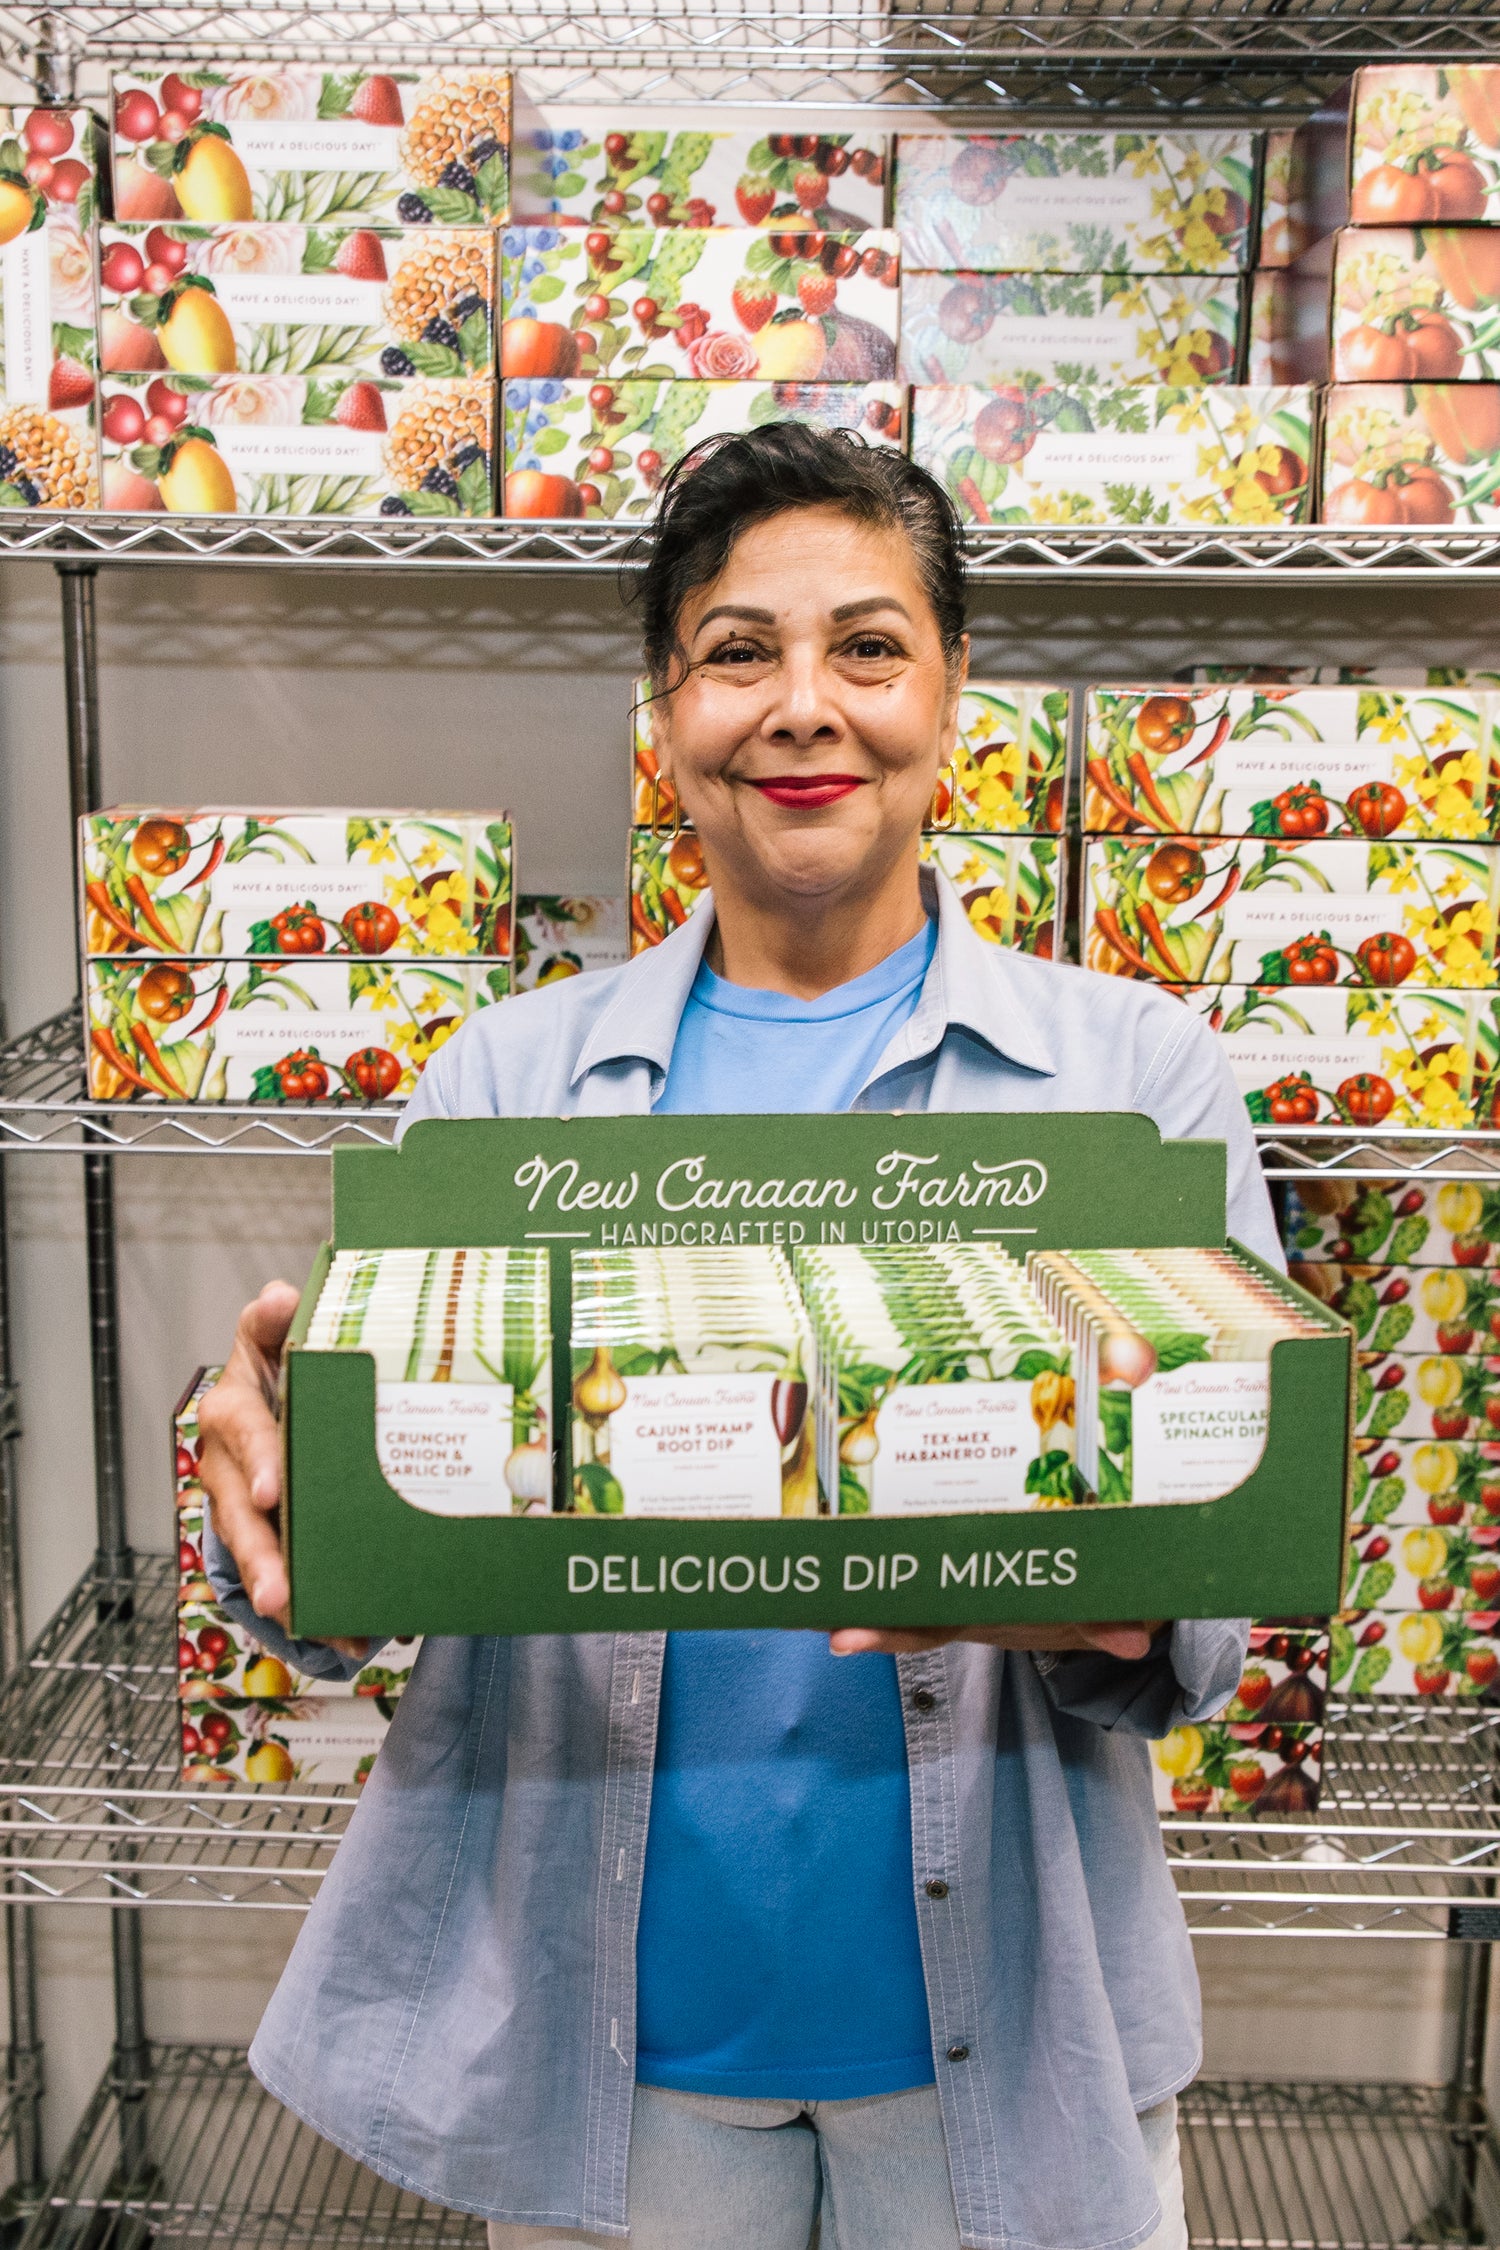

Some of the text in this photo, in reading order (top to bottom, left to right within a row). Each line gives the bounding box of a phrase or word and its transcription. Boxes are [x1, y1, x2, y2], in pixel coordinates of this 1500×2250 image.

[247, 142, 274, 150] HAVE
[290, 142, 348, 151] DELICIOUS
[274, 296, 331, 304] DELICIOUS
[232, 446, 258, 454] HAVE
[274, 446, 331, 455] DELICIOUS
[1044, 454, 1072, 462] HAVE
[1088, 454, 1146, 463] DELICIOUS
[1236, 762, 1264, 770] HAVE
[1280, 762, 1340, 771] DELICIOUS
[232, 884, 260, 892] HAVE
[276, 884, 334, 892] DELICIOUS
[1246, 912, 1274, 920] HAVE
[1290, 913, 1350, 922] DELICIOUS
[237, 1030, 264, 1038] HAVE
[279, 1030, 336, 1038] DELICIOUS
[1272, 1054, 1330, 1062] DELICIOUS
[514, 1149, 1048, 1212] New Canaan Farms
[601, 1219, 962, 1246] HANDCRAFTED IN UTOPIA
[636, 1422, 754, 1438] CAJUN SWAMP
[1164, 1426, 1266, 1440] SPINACH DIP
[385, 1432, 467, 1444] CRUNCHY
[922, 1432, 991, 1446] TEX-MEX
[657, 1438, 734, 1452] ROOT DIP
[390, 1448, 463, 1460] ONION &
[896, 1446, 1018, 1463] HABANERO DIP
[445, 1464, 472, 1476] DIP
[567, 1547, 1078, 1594] DELICIOUS DIP MIXES
